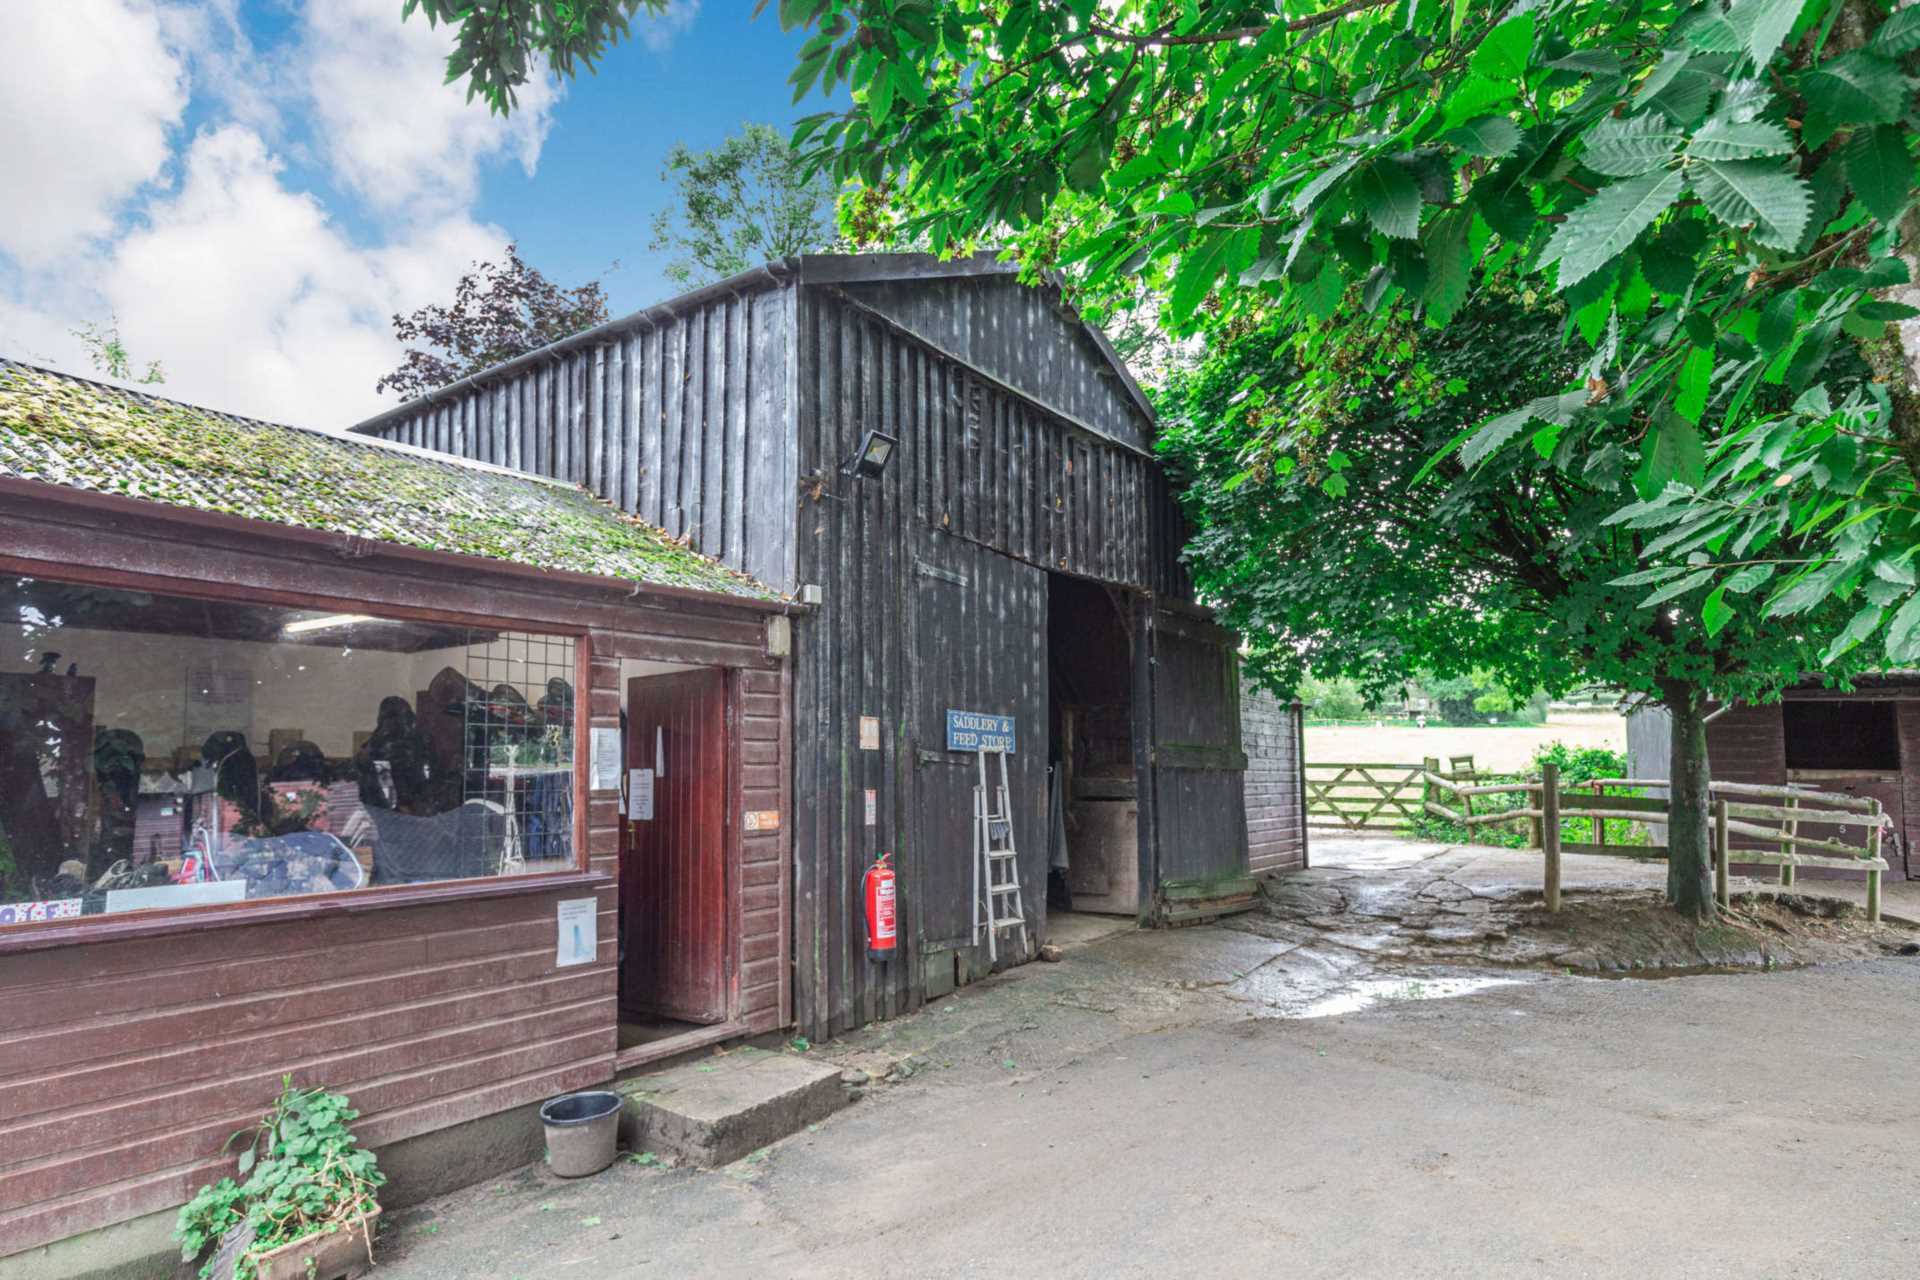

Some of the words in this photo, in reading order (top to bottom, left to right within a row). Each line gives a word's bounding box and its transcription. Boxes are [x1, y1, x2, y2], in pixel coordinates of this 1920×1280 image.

[952, 715, 999, 731] SADDLERY
[1002, 720, 1009, 732] &
[953, 732, 978, 745] FEED
[981, 735, 1012, 748] STORE
